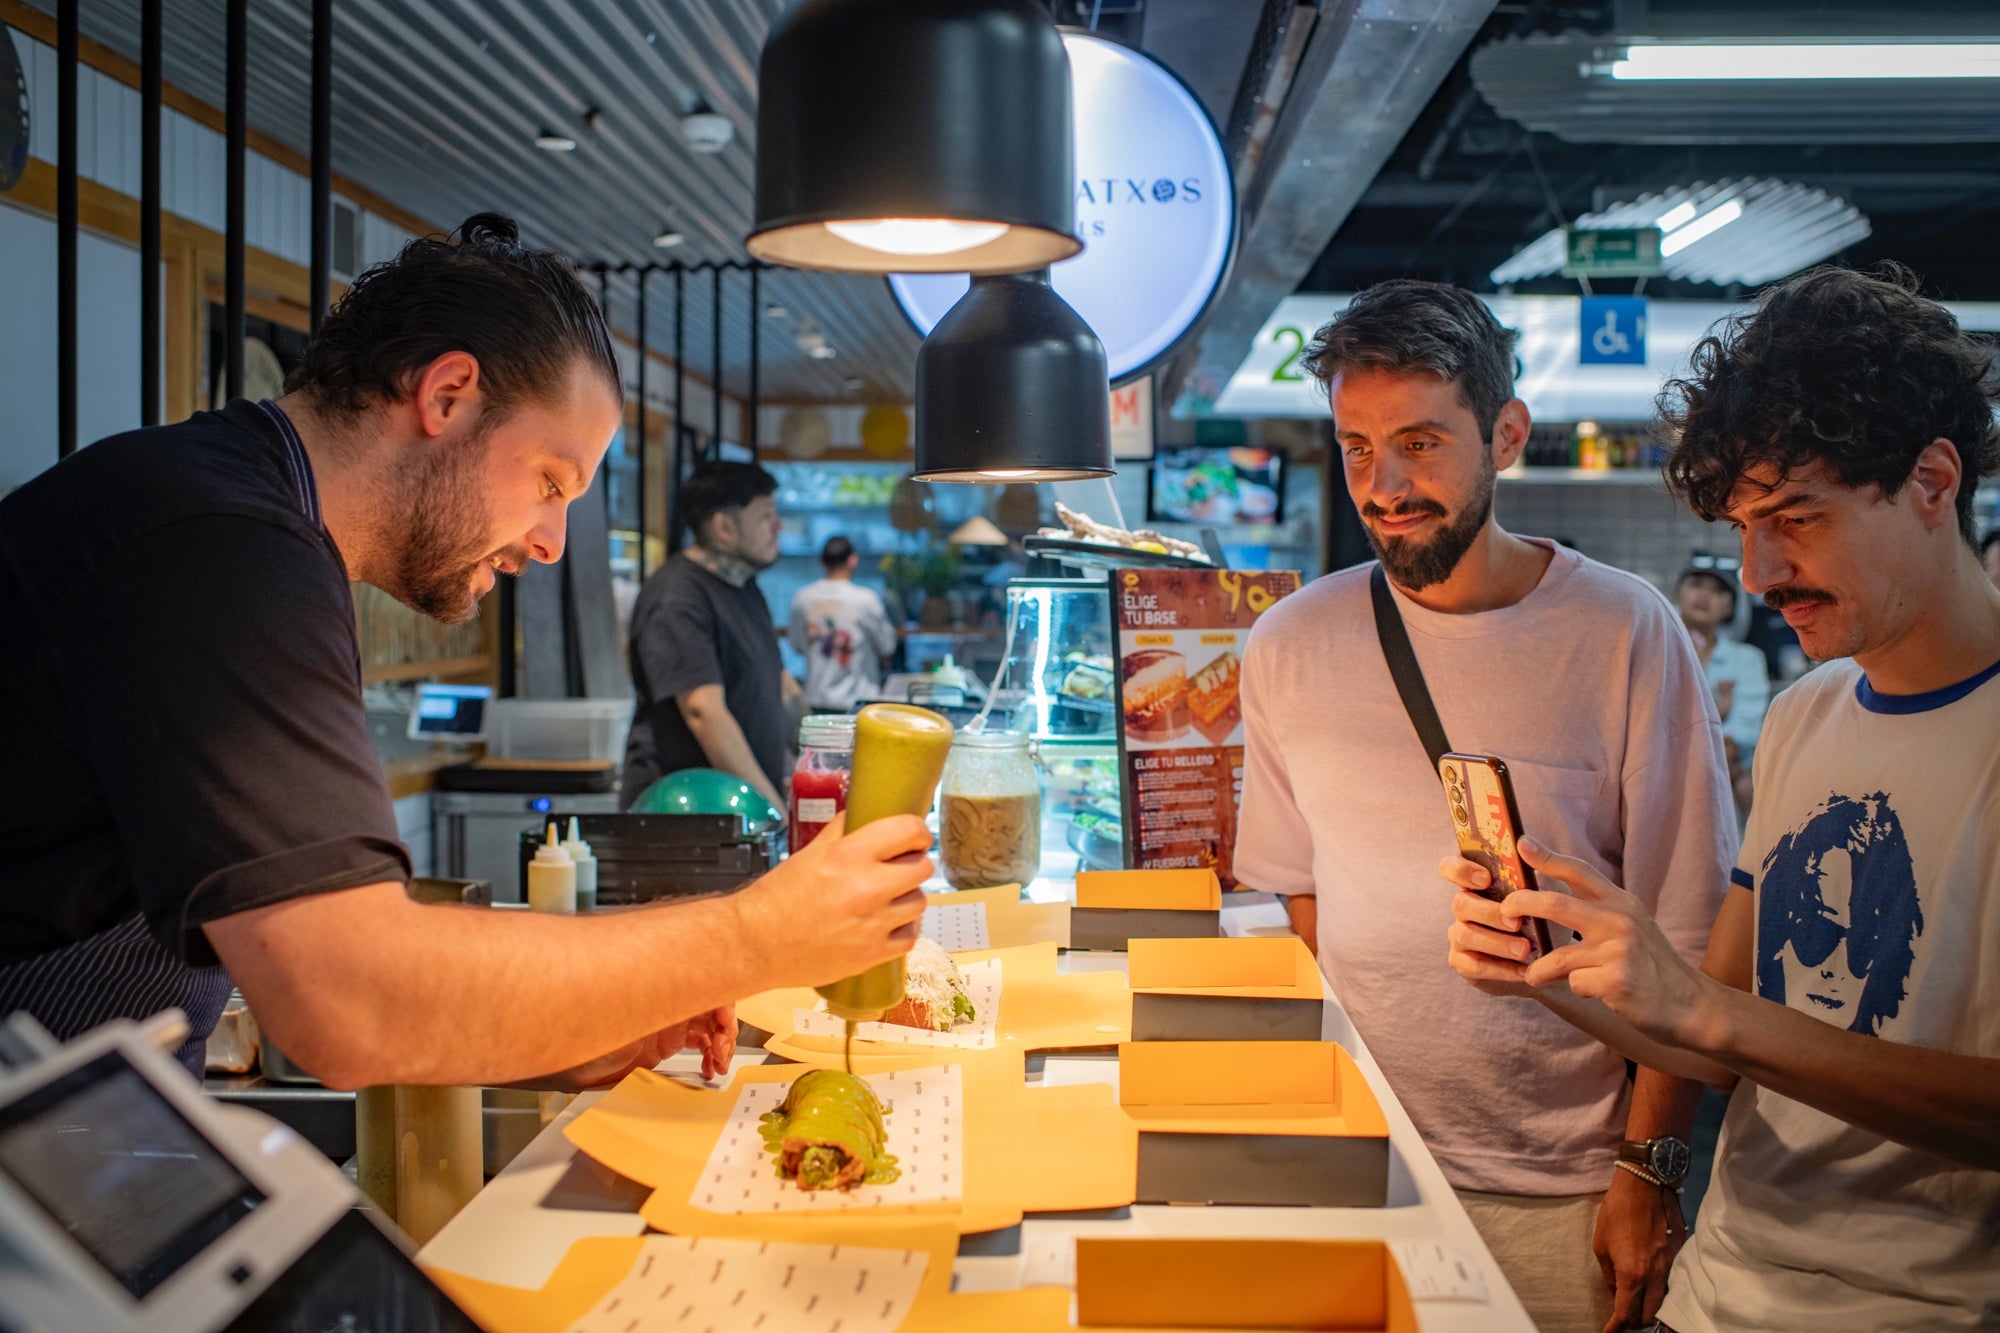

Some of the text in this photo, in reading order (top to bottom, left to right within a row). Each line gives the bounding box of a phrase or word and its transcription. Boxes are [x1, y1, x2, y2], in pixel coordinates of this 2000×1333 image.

[1076, 177, 1202, 204] ATXOS
[1124, 594, 1158, 610] ELIGE
[1125, 611, 1177, 625] TU BASE
[1135, 758, 1159, 770] ELIGE
[1161, 756, 1173, 768] TU
